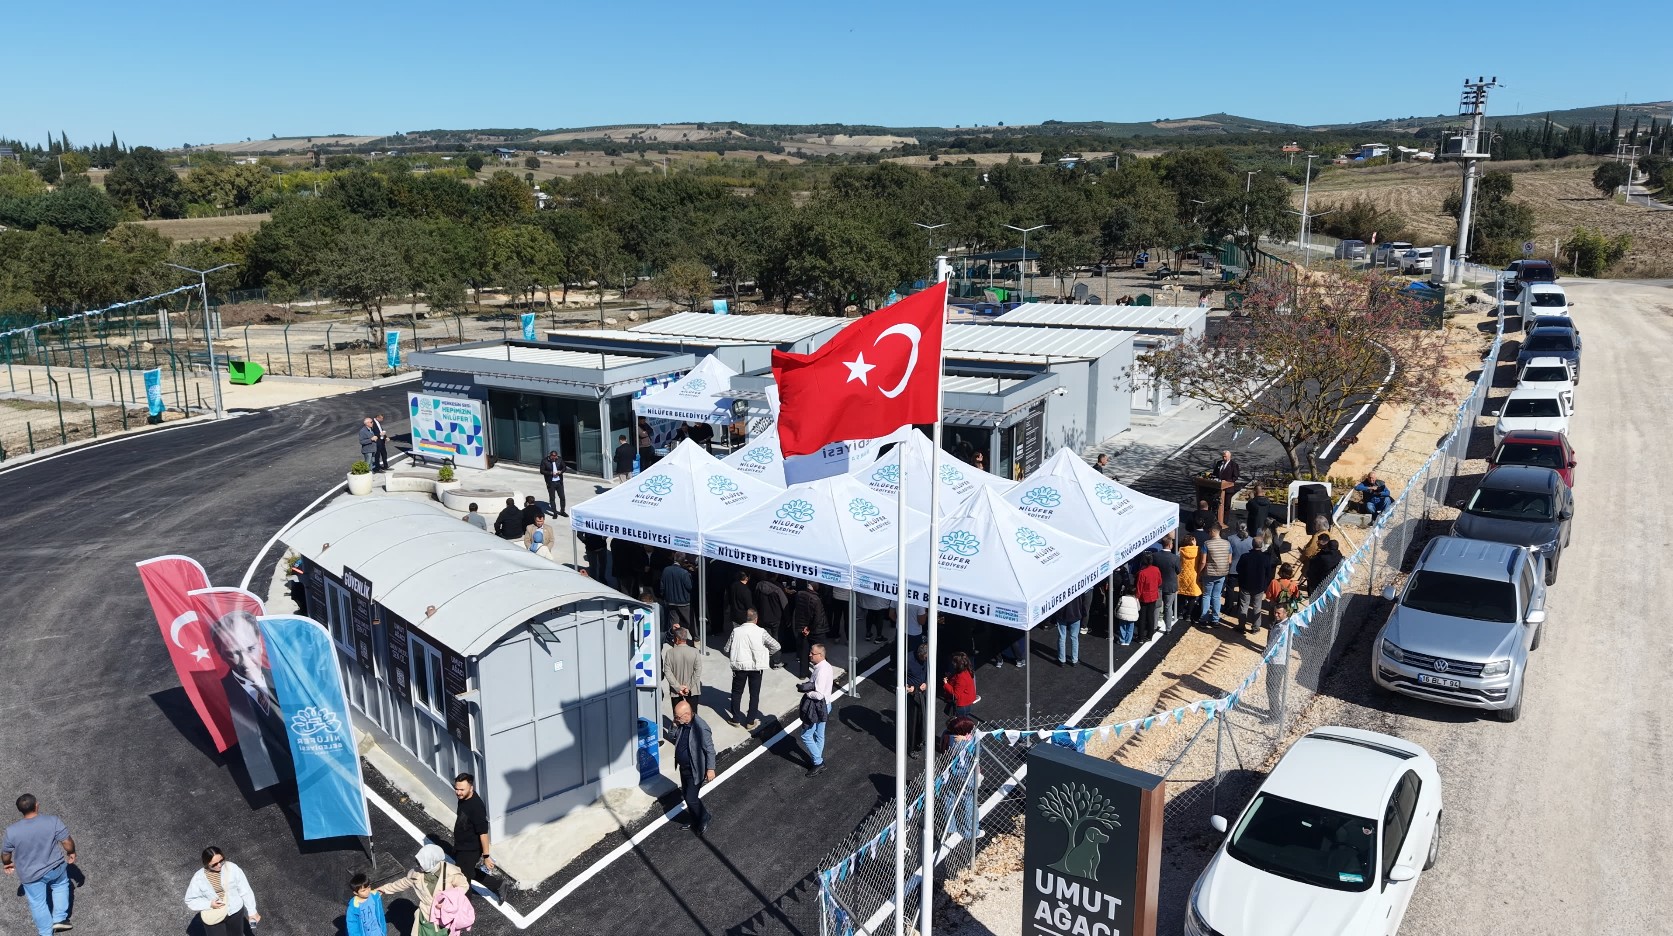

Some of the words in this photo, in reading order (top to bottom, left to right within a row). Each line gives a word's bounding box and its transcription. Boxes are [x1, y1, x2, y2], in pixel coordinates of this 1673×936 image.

[647, 407, 673, 416] NİLÜFER
[740, 462, 766, 470] NİLÜFER
[869, 482, 899, 490] NİLÜFER
[635, 494, 662, 502] NİLÜFER
[720, 491, 744, 501] NİLÜFER
[1019, 506, 1053, 515] NİLÜFER
[772, 519, 805, 530] NİLÜFER
[864, 515, 887, 528] NİLÜFER
[585, 520, 619, 534] NİLÜFER
[622, 527, 671, 544] BELEDİYESİ
[769, 525, 801, 535] BELEDİYESİ
[718, 546, 758, 563] NİLÜFER
[761, 556, 818, 576] BELEDİYESİ
[939, 553, 970, 565] İLÜFER
[344, 571, 370, 600] GÜVENLİK
[1041, 591, 1067, 615] NİLÜFER
[1067, 567, 1099, 597] BELEDİYESİ
[873, 581, 919, 601] NİLÜER
[923, 596, 990, 616] BLEDİYESİ
[1036, 868, 1122, 920] UMUT
